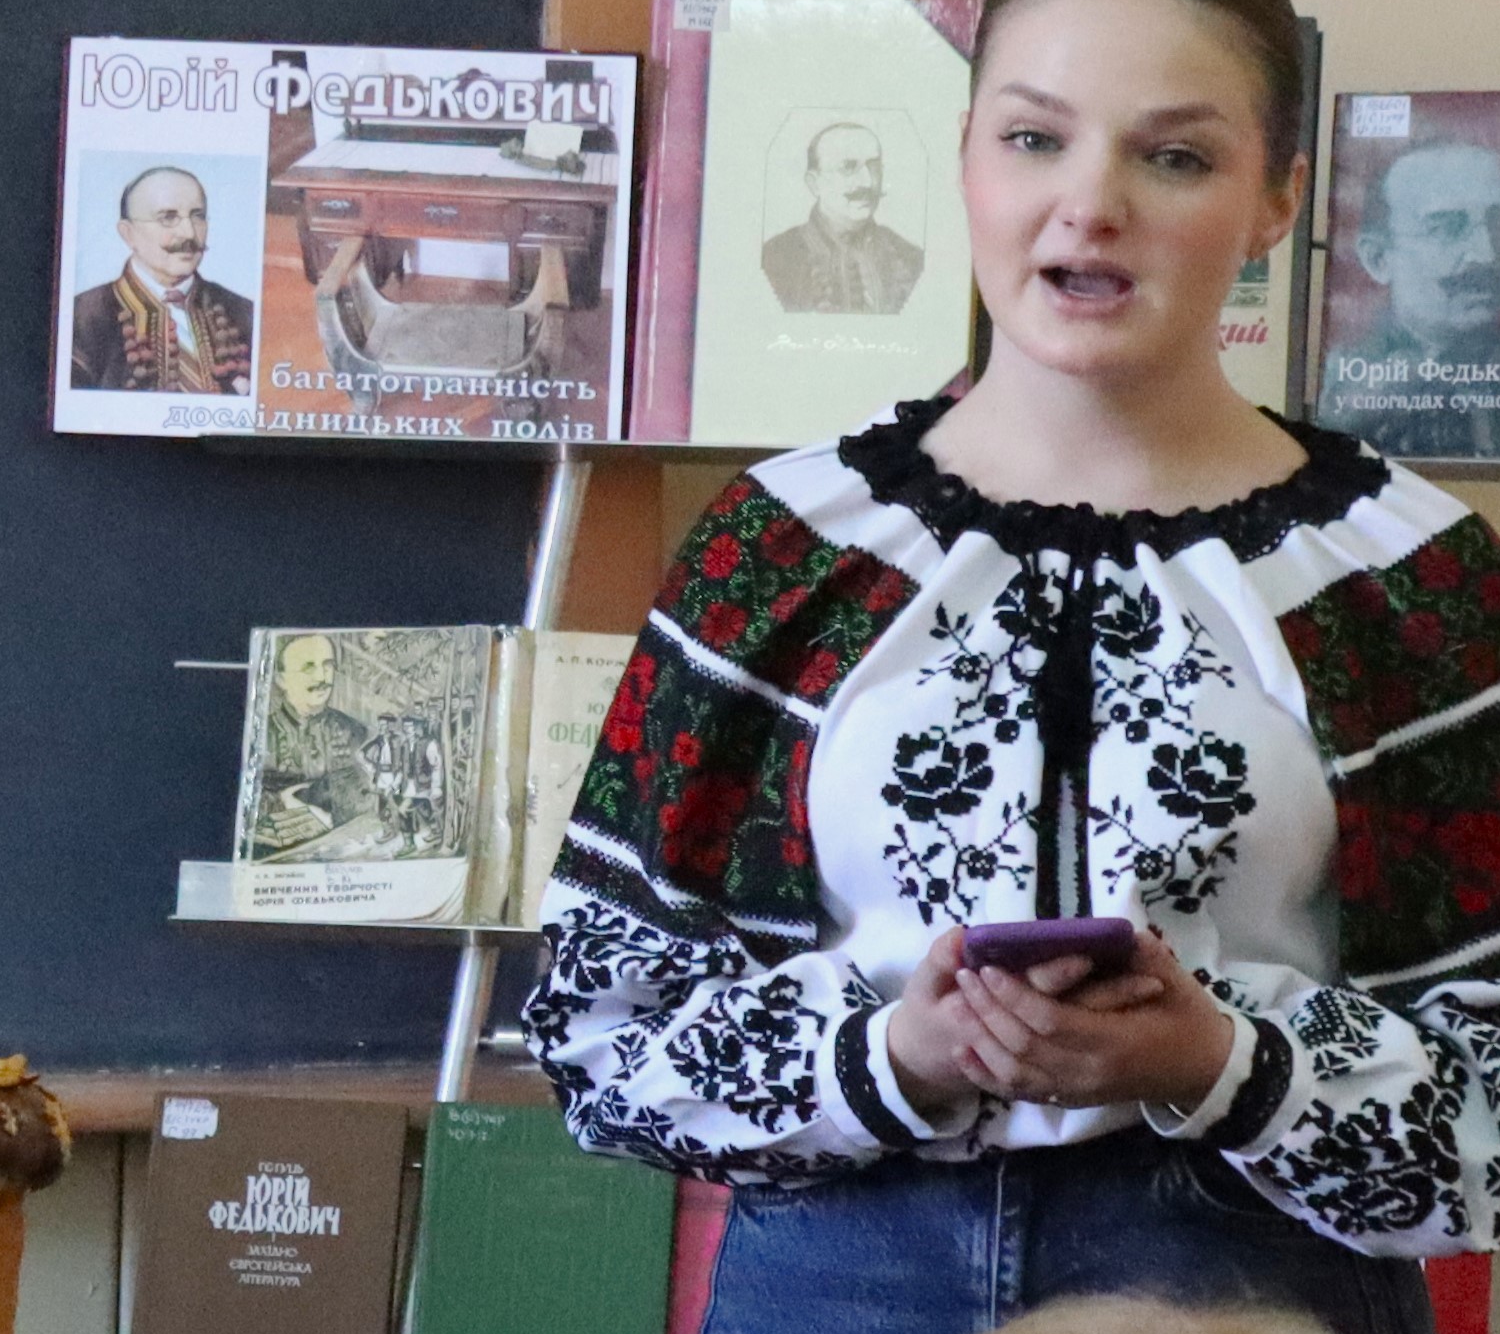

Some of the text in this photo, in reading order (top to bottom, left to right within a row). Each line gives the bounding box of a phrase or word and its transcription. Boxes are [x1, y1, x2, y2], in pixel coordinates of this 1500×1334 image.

[80, 53, 613, 126] Юрій Федькович
[271, 361, 597, 402] багатогранність
[1337, 357, 1409, 388] Юрій
[1334, 394, 1350, 414] у
[1352, 394, 1445, 411] спогадах
[163, 404, 595, 441] дослідницьких полів
[253, 894, 377, 907] ЮРІЯ ФЕДЬКОВИЧА
[254, 882, 393, 896] ВИВЧЕННЯ ТВОРЧОСТІ
[246, 1174, 311, 1207] ЮРІЙ
[208, 1200, 341, 1235] ФЕДЬКОВИЧ
[247, 1244, 298, 1257] ЗАХІДНО
[229, 1258, 312, 1274] ЄВРОПЕЙСЬКА
[238, 1273, 300, 1287] ЛІТЕРАТУРА
